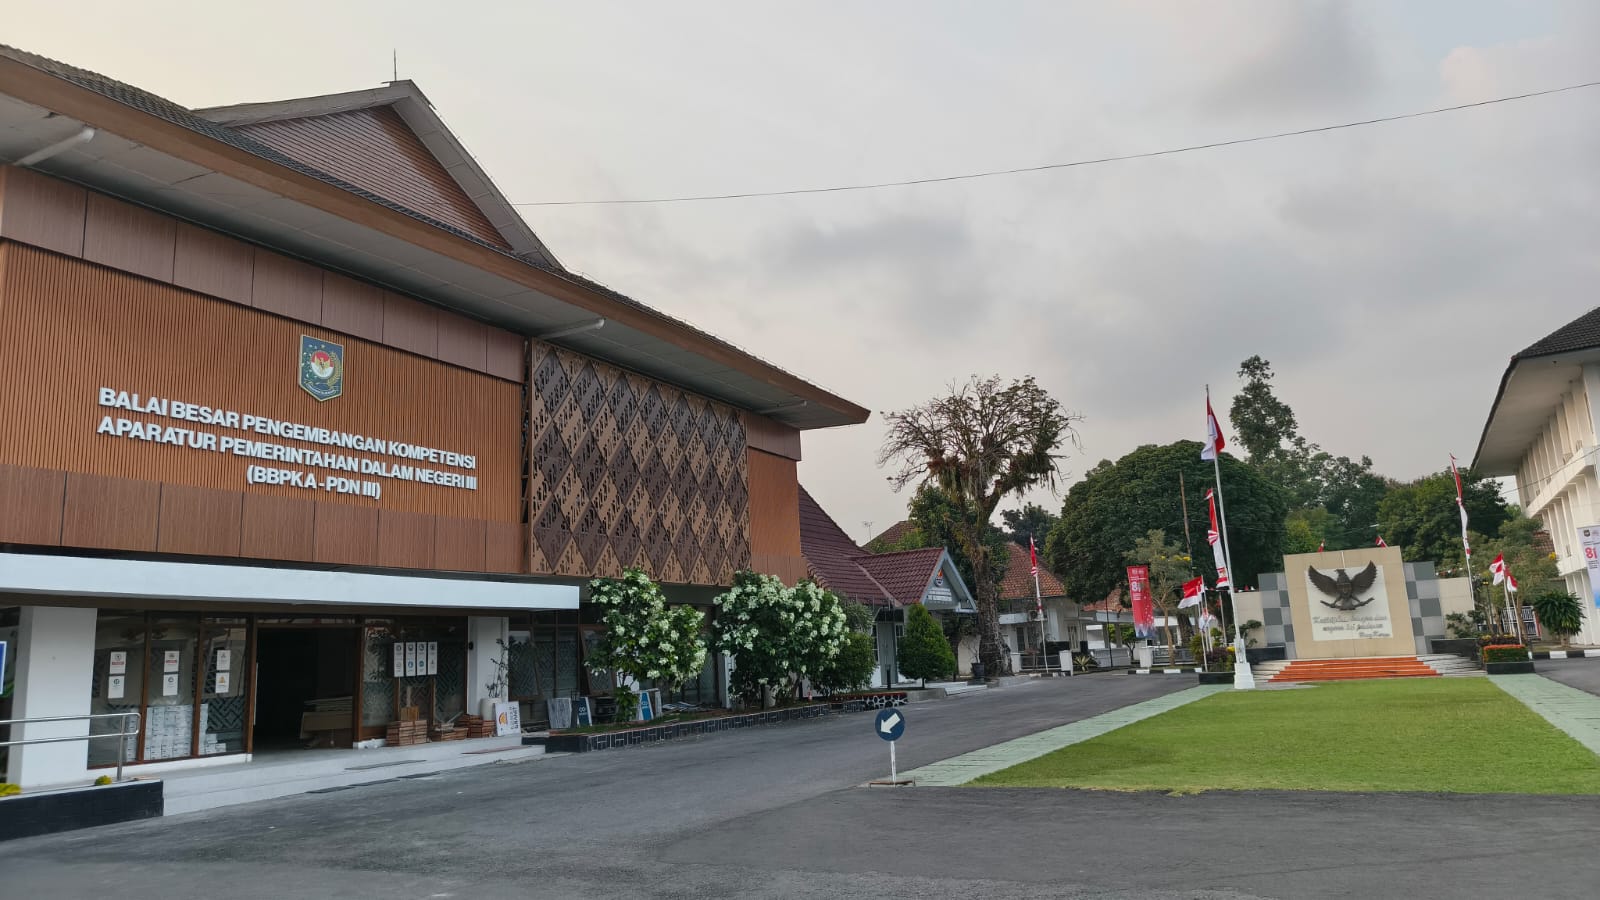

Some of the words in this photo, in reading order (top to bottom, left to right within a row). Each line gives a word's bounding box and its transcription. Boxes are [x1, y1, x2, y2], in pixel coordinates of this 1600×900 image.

[97, 415, 216, 451] APARATUR
[220, 436, 359, 472] PEMERINTAHAN
[361, 459, 413, 481] DALAM
[415, 468, 465, 488] NEGERI
[466, 476, 477, 490] III
[99, 387, 168, 416] BALAI
[171, 400, 239, 429] BESAR
[242, 414, 386, 454] PENGEMBANGAN
[388, 441, 476, 469] KOMPETENSI
[362, 480, 381, 499] III)
